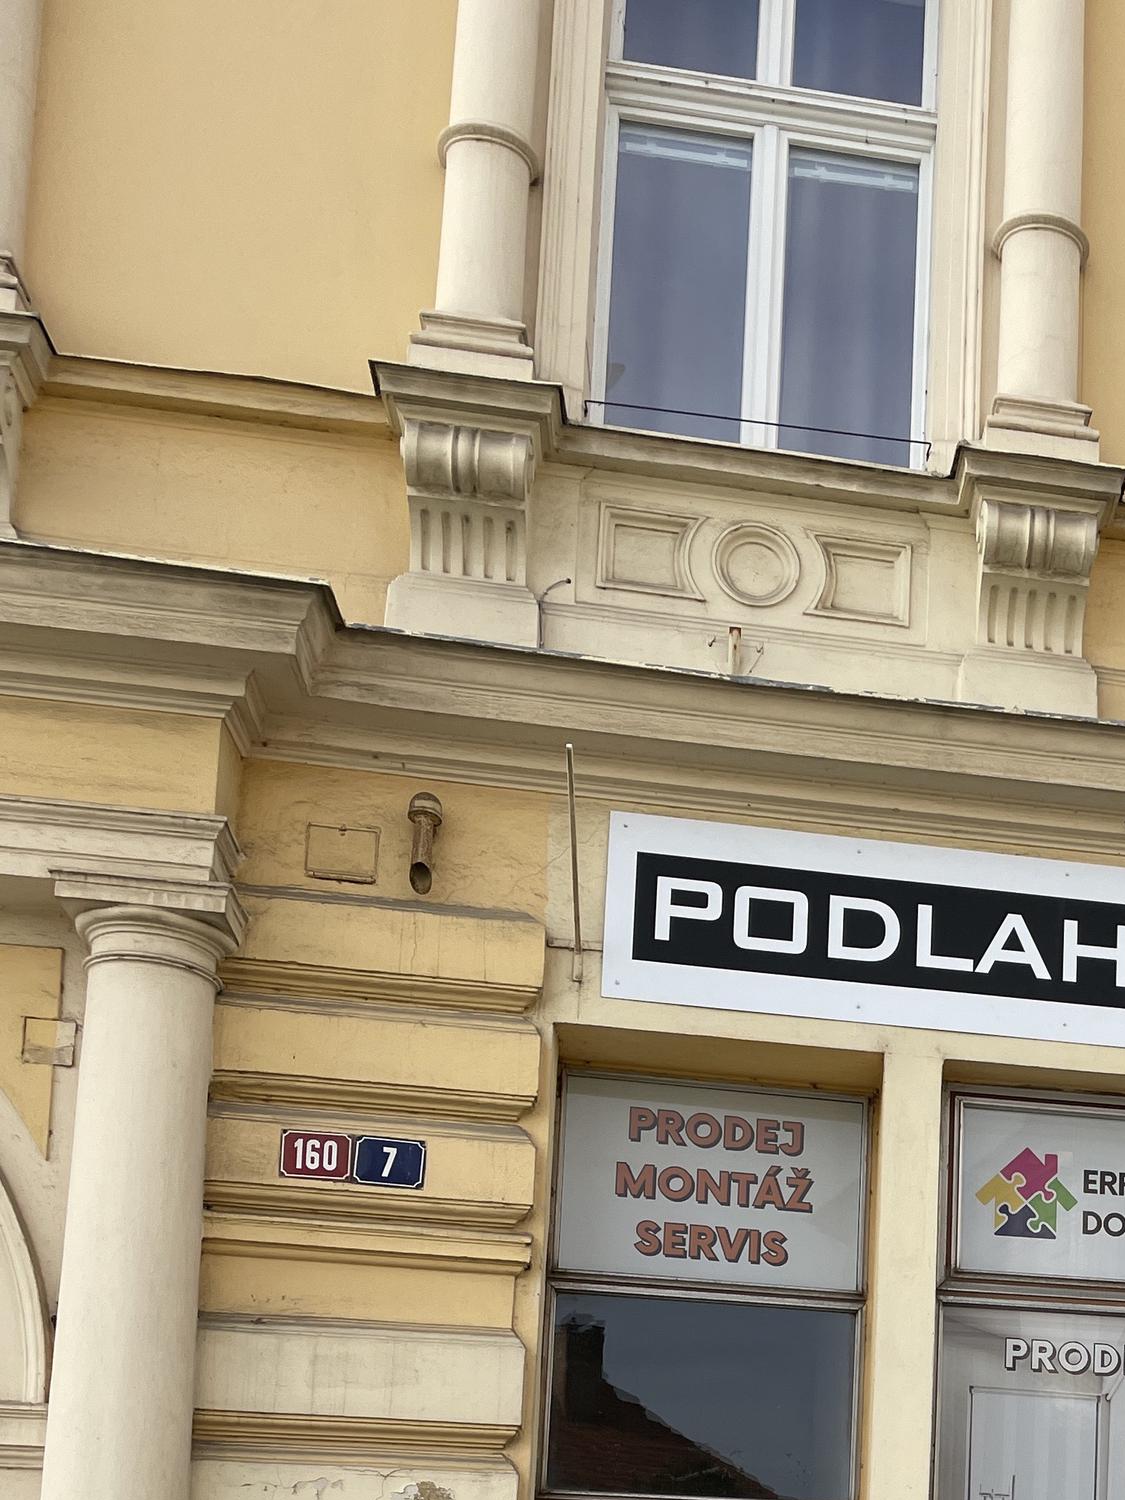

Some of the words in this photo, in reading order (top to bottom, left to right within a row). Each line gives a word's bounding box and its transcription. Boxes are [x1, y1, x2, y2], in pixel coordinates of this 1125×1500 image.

[294, 1138, 338, 1171] 160
[628, 1106, 805, 1157] PRODEJ
[381, 1146, 398, 1177] 7
[614, 1161, 814, 1213] MONTÁŽ
[634, 1219, 789, 1266] SERVIS
